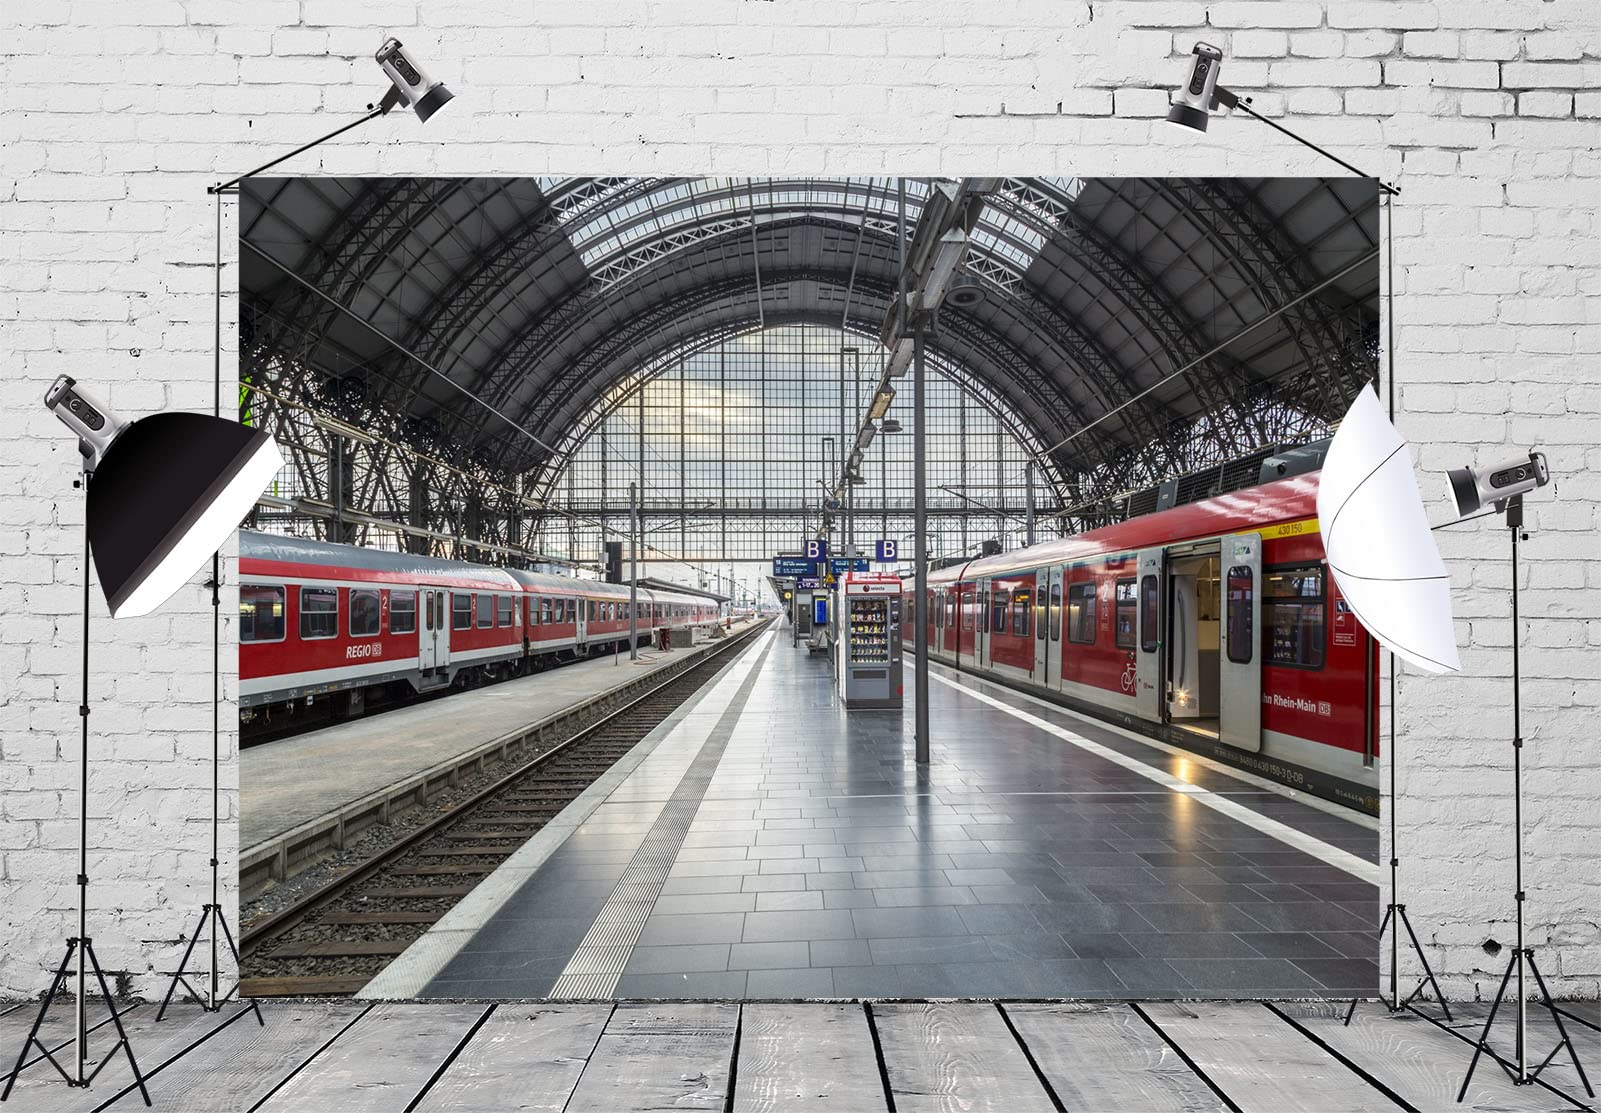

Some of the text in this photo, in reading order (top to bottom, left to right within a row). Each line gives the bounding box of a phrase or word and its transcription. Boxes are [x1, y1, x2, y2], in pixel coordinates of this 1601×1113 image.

[808, 540, 819, 558] B
[884, 540, 896, 558] B
[382, 596, 388, 609] 2
[346, 644, 371, 658] REGIO
[1263, 693, 1330, 715] hn Rhein-Main DB
